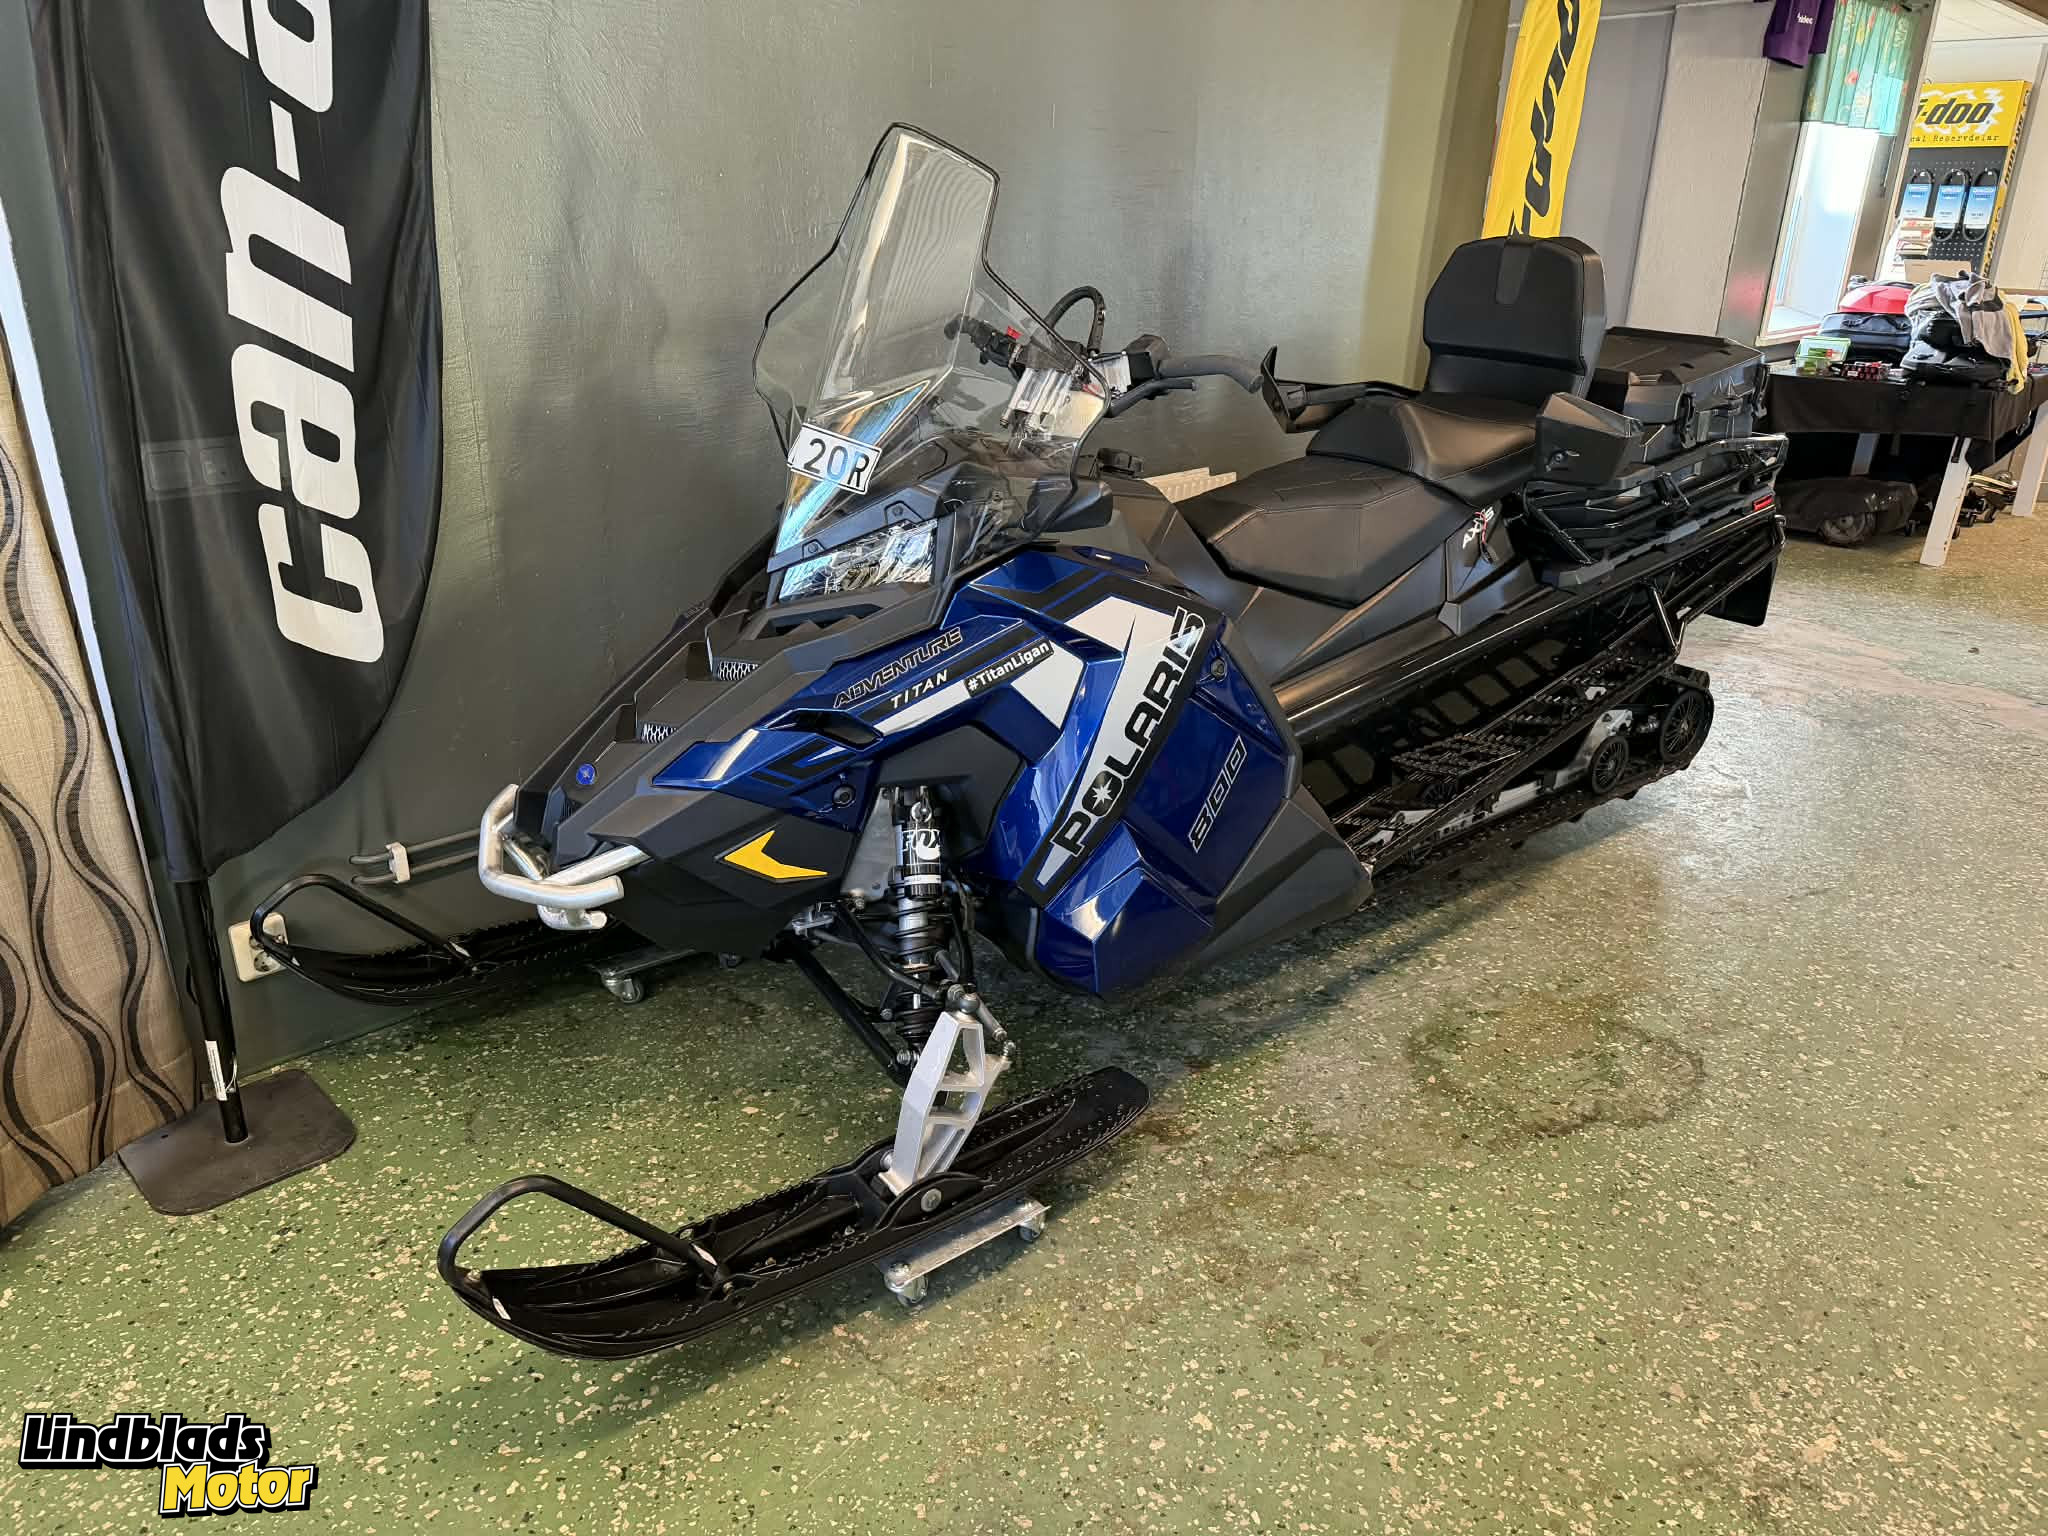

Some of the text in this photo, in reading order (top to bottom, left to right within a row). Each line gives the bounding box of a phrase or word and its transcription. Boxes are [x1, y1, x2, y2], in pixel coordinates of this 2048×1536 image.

[803, 438, 870, 487] 20R
[833, 627, 963, 708] ADVENTURE
[890, 669, 948, 709] TITAN
[968, 641, 1050, 691] #TitanLigan
[1050, 606, 1205, 857] POLARIS
[1187, 735, 1248, 853] 800
